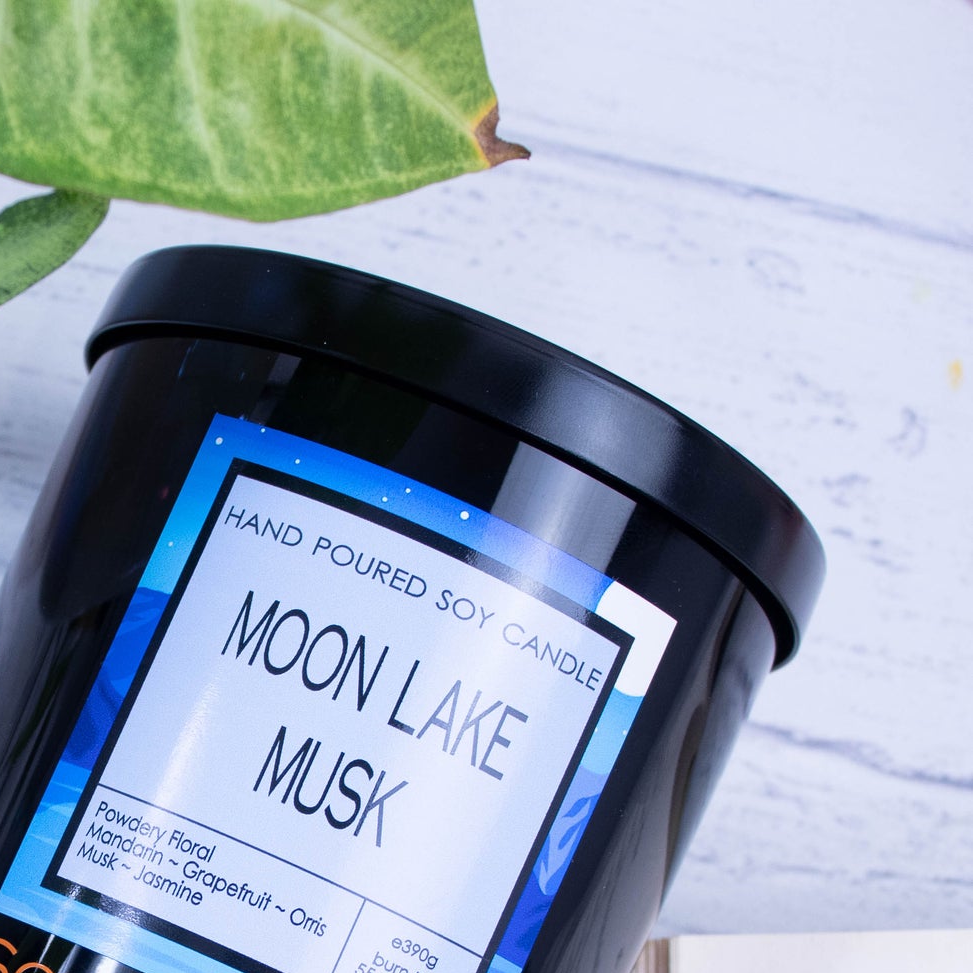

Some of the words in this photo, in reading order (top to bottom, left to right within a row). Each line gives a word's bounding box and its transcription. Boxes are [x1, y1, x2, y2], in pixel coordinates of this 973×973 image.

[224, 506, 303, 547] HAND
[312, 536, 427, 598] POURED
[435, 590, 495, 629] SOY
[503, 623, 603, 691] CANDLE
[221, 590, 389, 713] MOON
[388, 660, 528, 781] LAKE
[95, 801, 167, 842] Powdery
[168, 830, 217, 862] Floral
[253, 726, 409, 848] MUSK
[77, 842, 119, 871] Musk
[133, 864, 203, 906] Jasmine
[85, 822, 164, 866] Mandarin
[183, 861, 272, 911] Grapefruit
[289, 908, 327, 937] Orris
[391, 937, 439, 970] e390g
